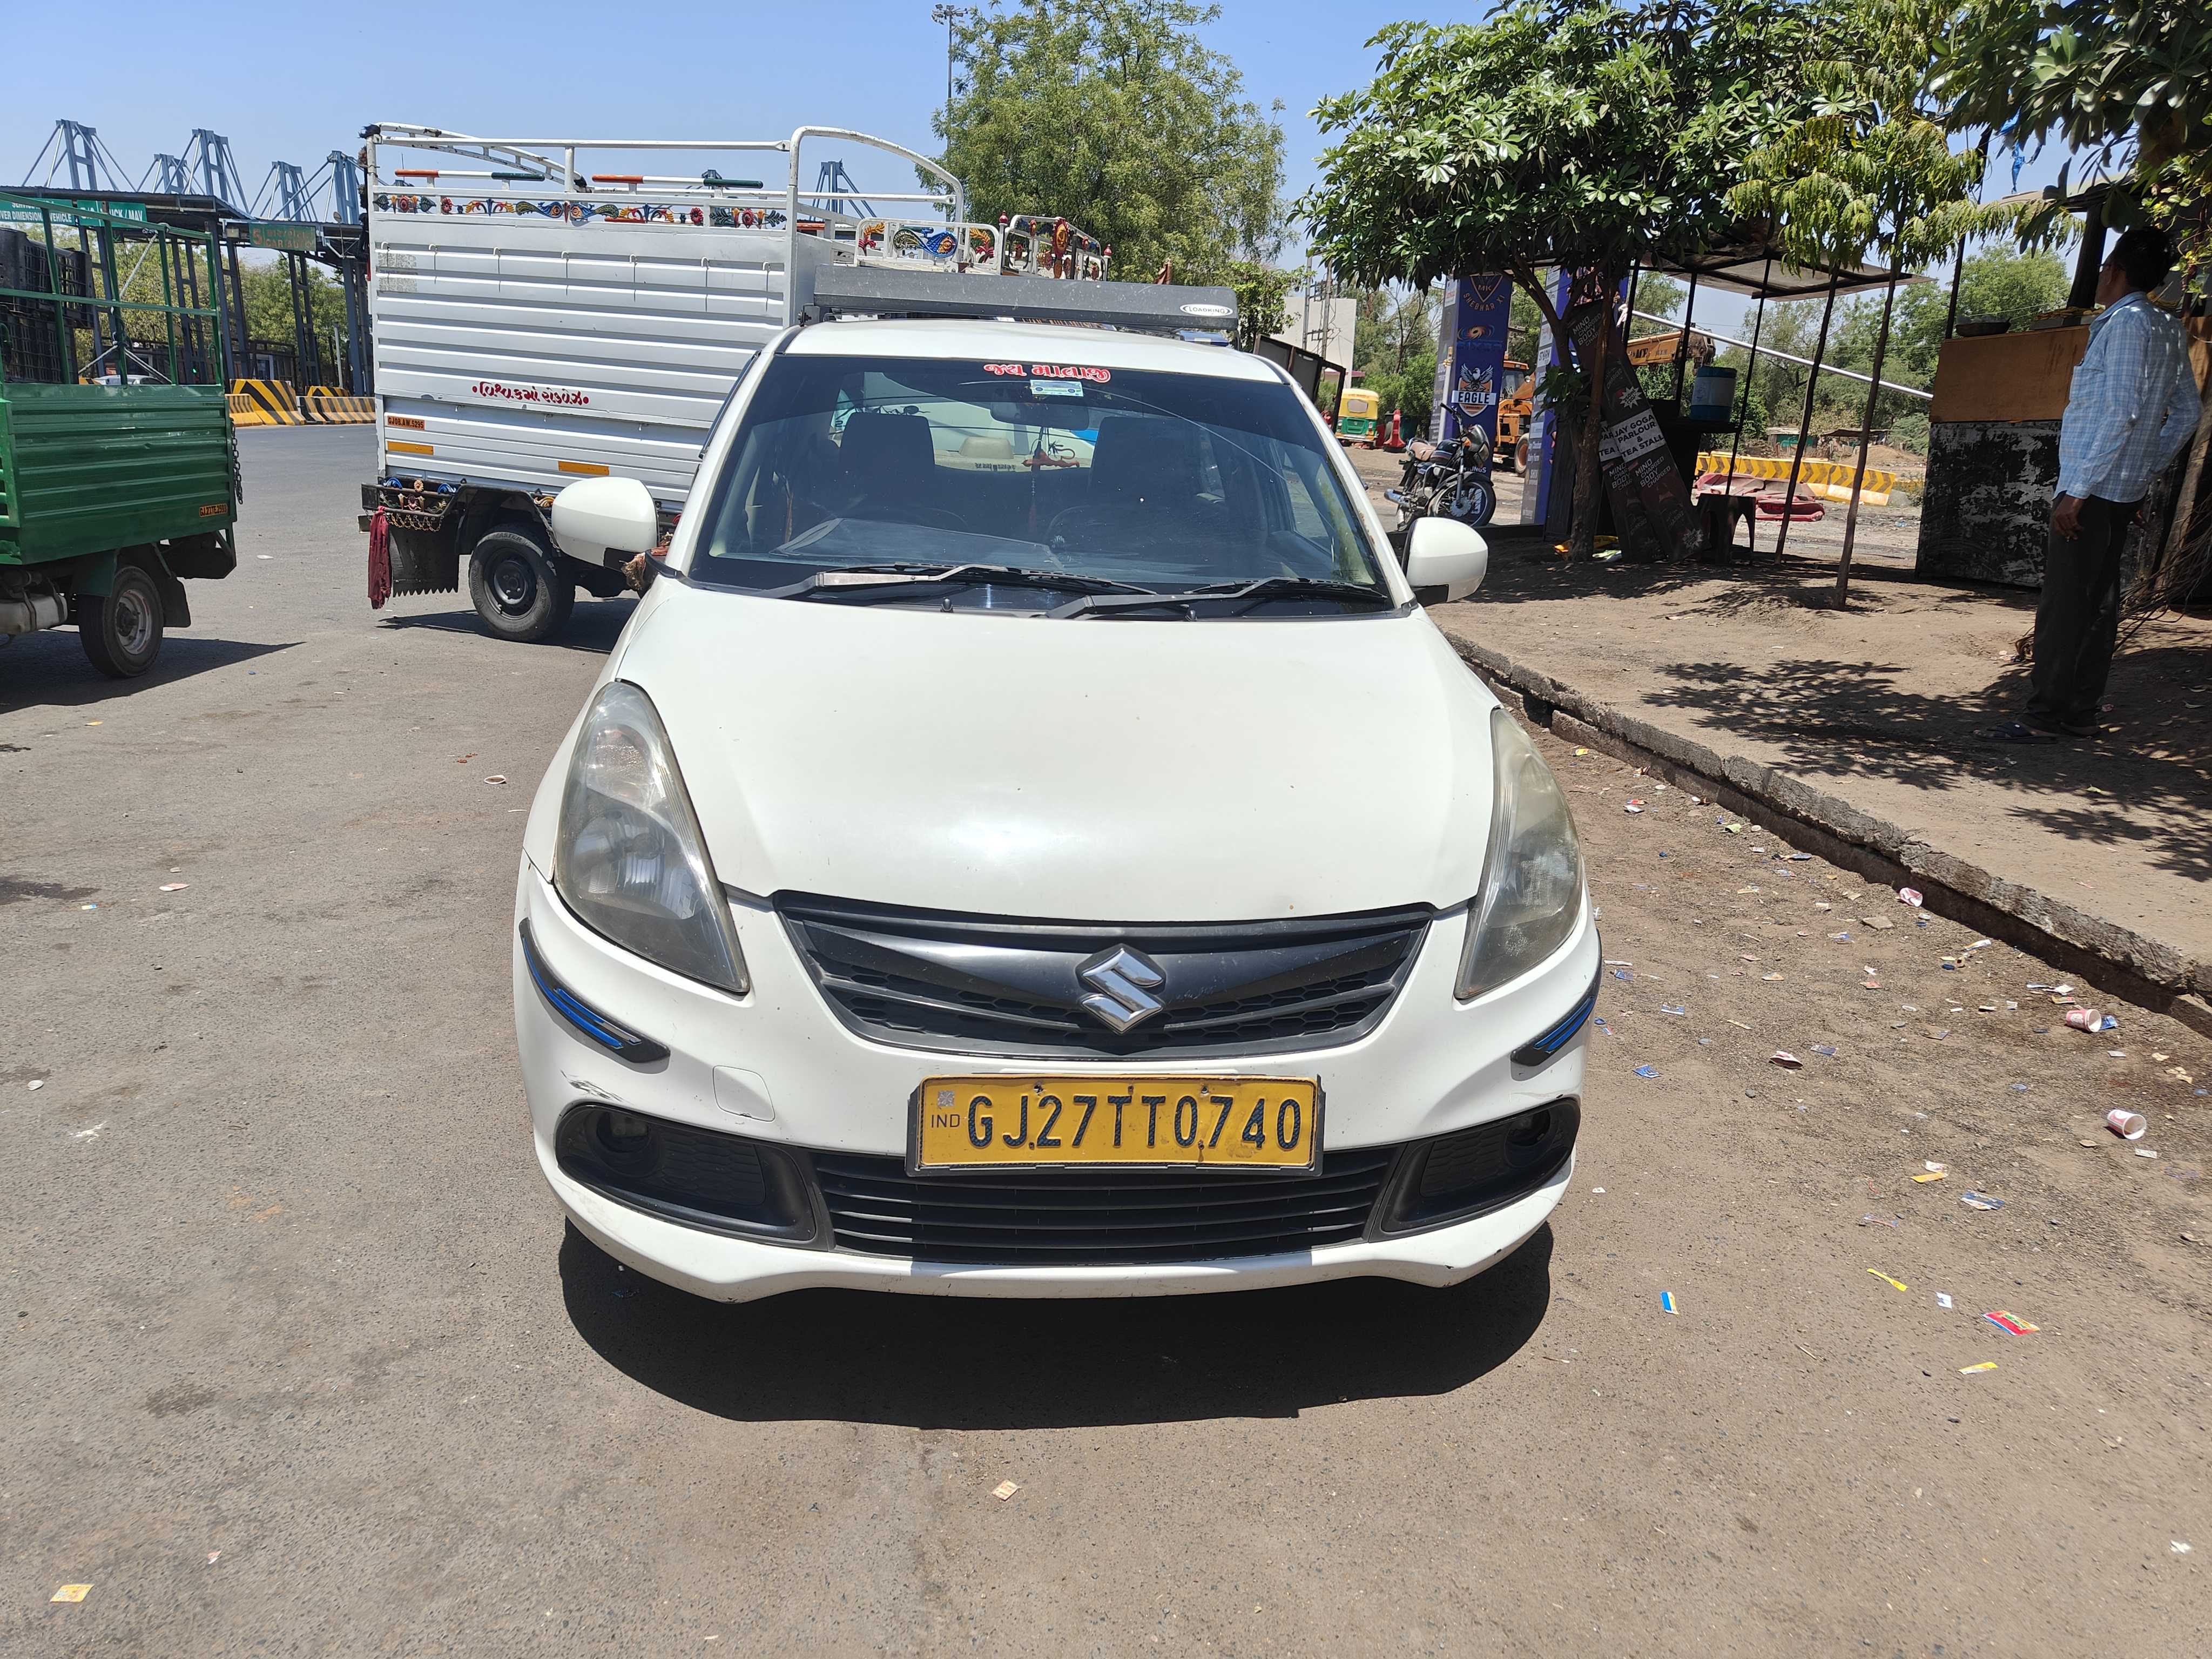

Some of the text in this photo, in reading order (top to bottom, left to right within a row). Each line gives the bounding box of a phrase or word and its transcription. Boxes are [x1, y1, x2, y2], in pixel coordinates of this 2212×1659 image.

[0, 210, 11, 220] VER
[12, 211, 43, 221] DIMENSION
[49, 213, 72, 222] VEHICLE
[1573, 316, 1590, 335] MIND
[1577, 325, 1595, 346] BODY
[1585, 332, 1599, 346] CHAR
[1459, 392, 1490, 404] EAGLE
[1615, 414, 1655, 437] JAY GOGA
[1618, 422, 1656, 443] PARLOUR
[1599, 447, 1615, 456] TEA
[1621, 434, 1664, 457] TEA STALL
[1614, 468, 1629, 480] CHAR
[1635, 458, 1653, 476] MIND
[1641, 456, 1664, 478] CHARGED
[1618, 479, 1633, 490] CHAR
[1640, 468, 1658, 487] BODY
[1647, 466, 1670, 488] CHARGED
[932, 1095, 1301, 1151] IND GJ27TT0740
